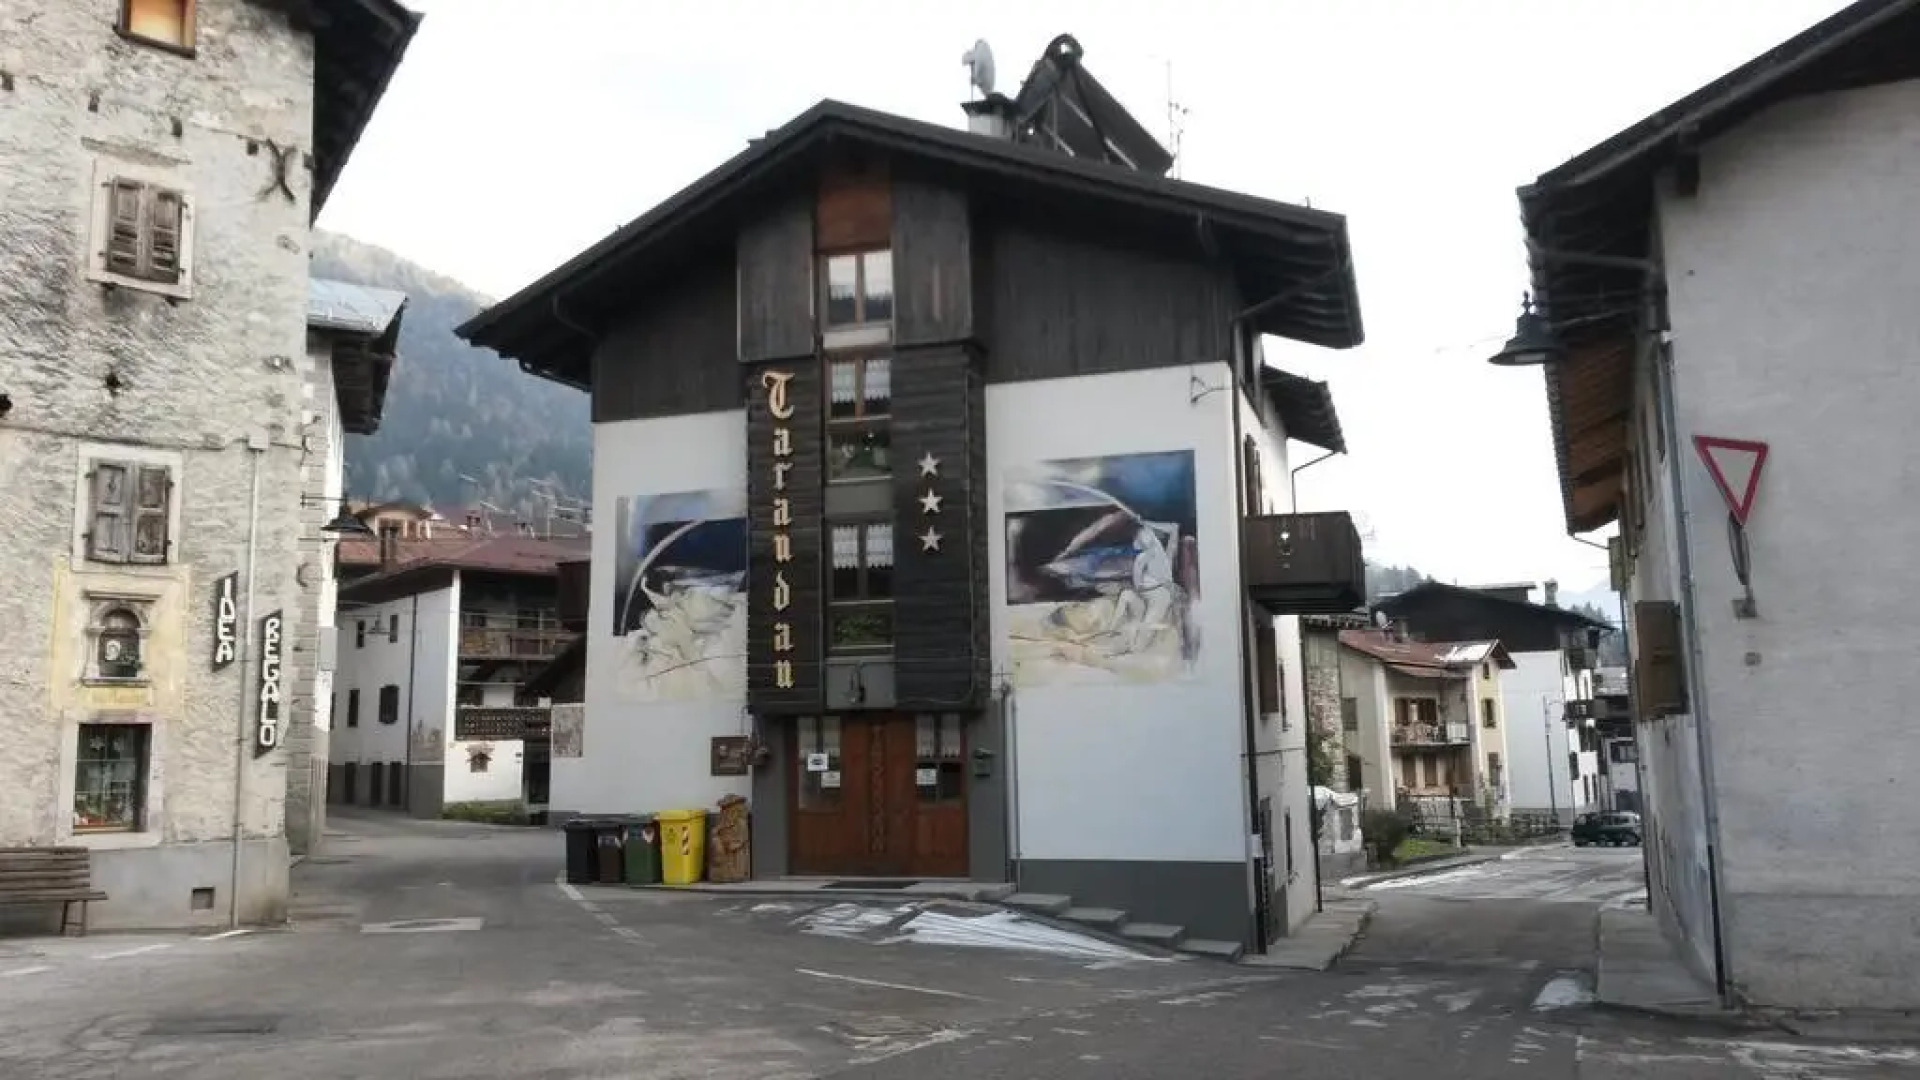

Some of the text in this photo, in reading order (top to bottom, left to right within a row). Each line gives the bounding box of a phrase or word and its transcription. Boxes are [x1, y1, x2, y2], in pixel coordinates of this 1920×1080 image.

[763, 372, 795, 688] Tarandan
[215, 578, 235, 662] IDEA
[260, 618, 280, 745] REGALO
